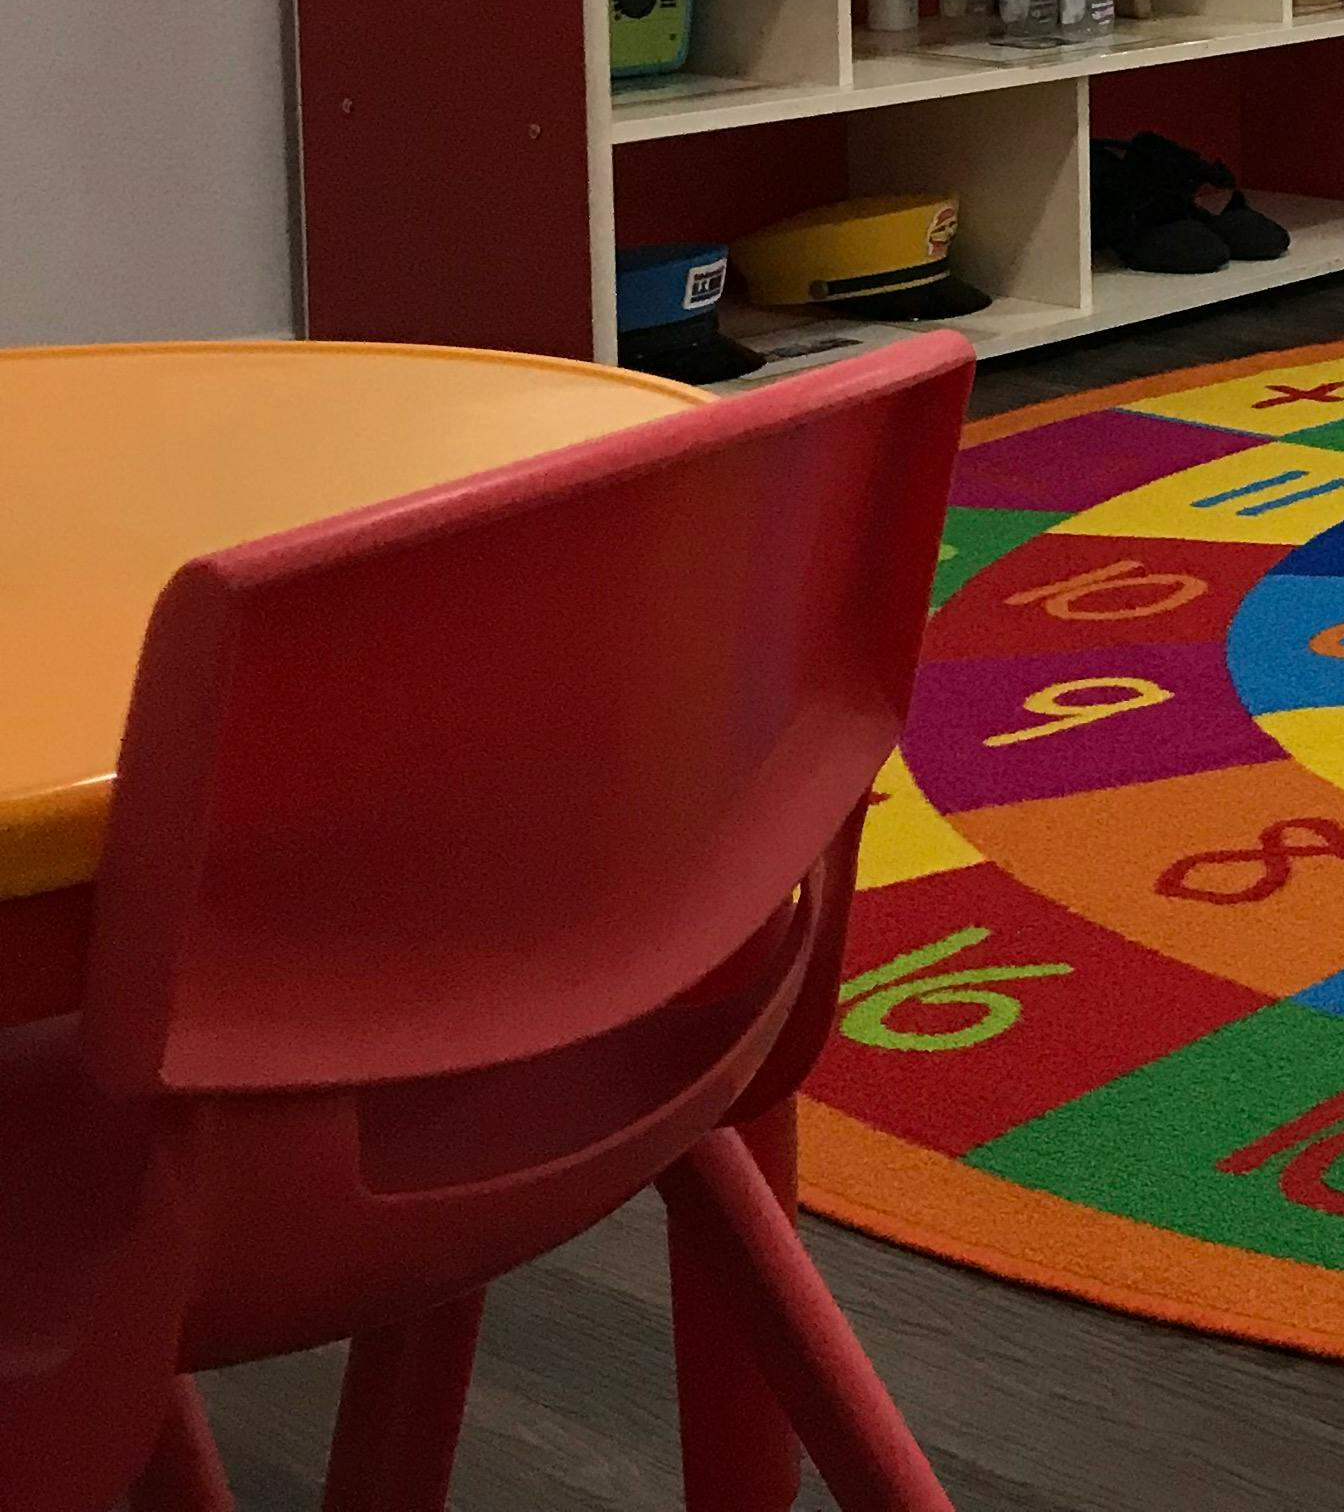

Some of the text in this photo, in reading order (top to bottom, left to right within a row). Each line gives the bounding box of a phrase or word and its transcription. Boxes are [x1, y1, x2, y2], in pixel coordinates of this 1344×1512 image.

[1003, 558, 1209, 621] 10
[983, 677, 1175, 747] 9
[838, 924, 1076, 1053] 16
